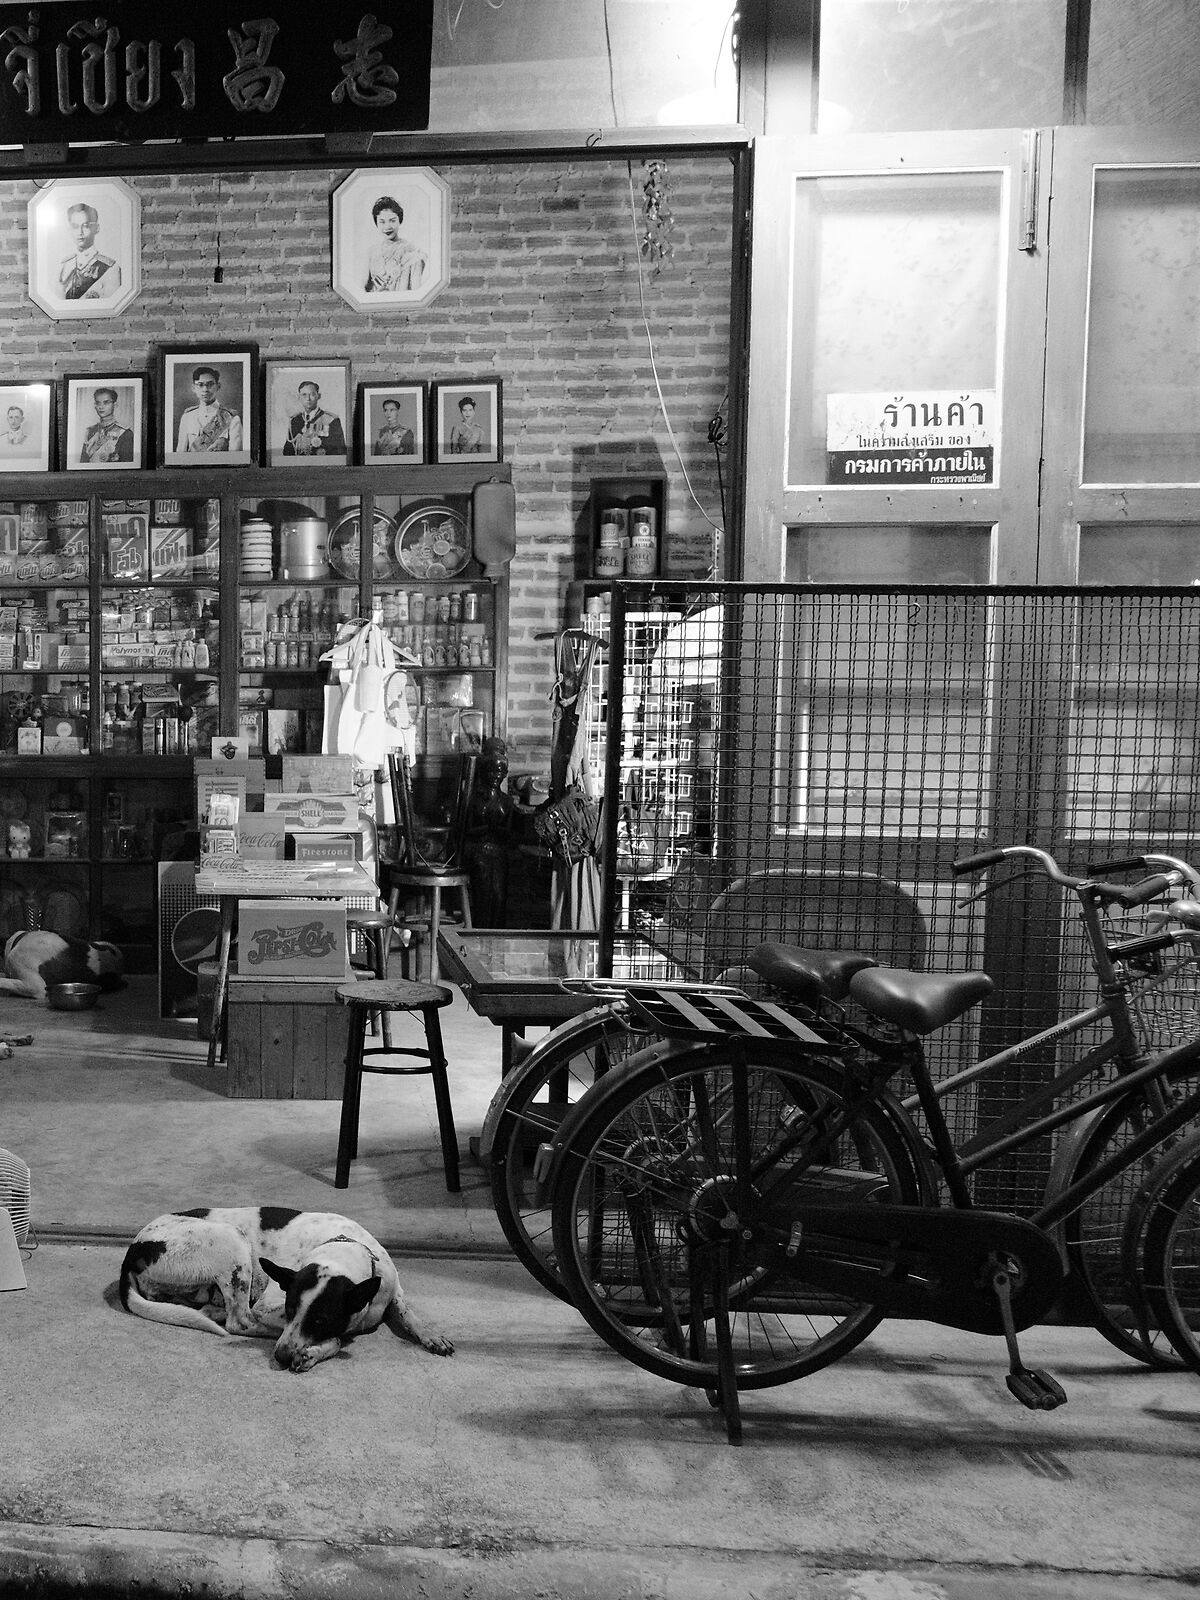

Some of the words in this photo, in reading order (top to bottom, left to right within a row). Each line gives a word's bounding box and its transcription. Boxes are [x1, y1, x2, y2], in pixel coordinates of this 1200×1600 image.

[883, 395, 984, 427] ร้านค้า
[845, 450, 986, 474] กรมการค้าภายใน
[111, 547, 142, 573] Fab
[301, 809, 321, 817] SHELL
[301, 848, 349, 857] Firestone
